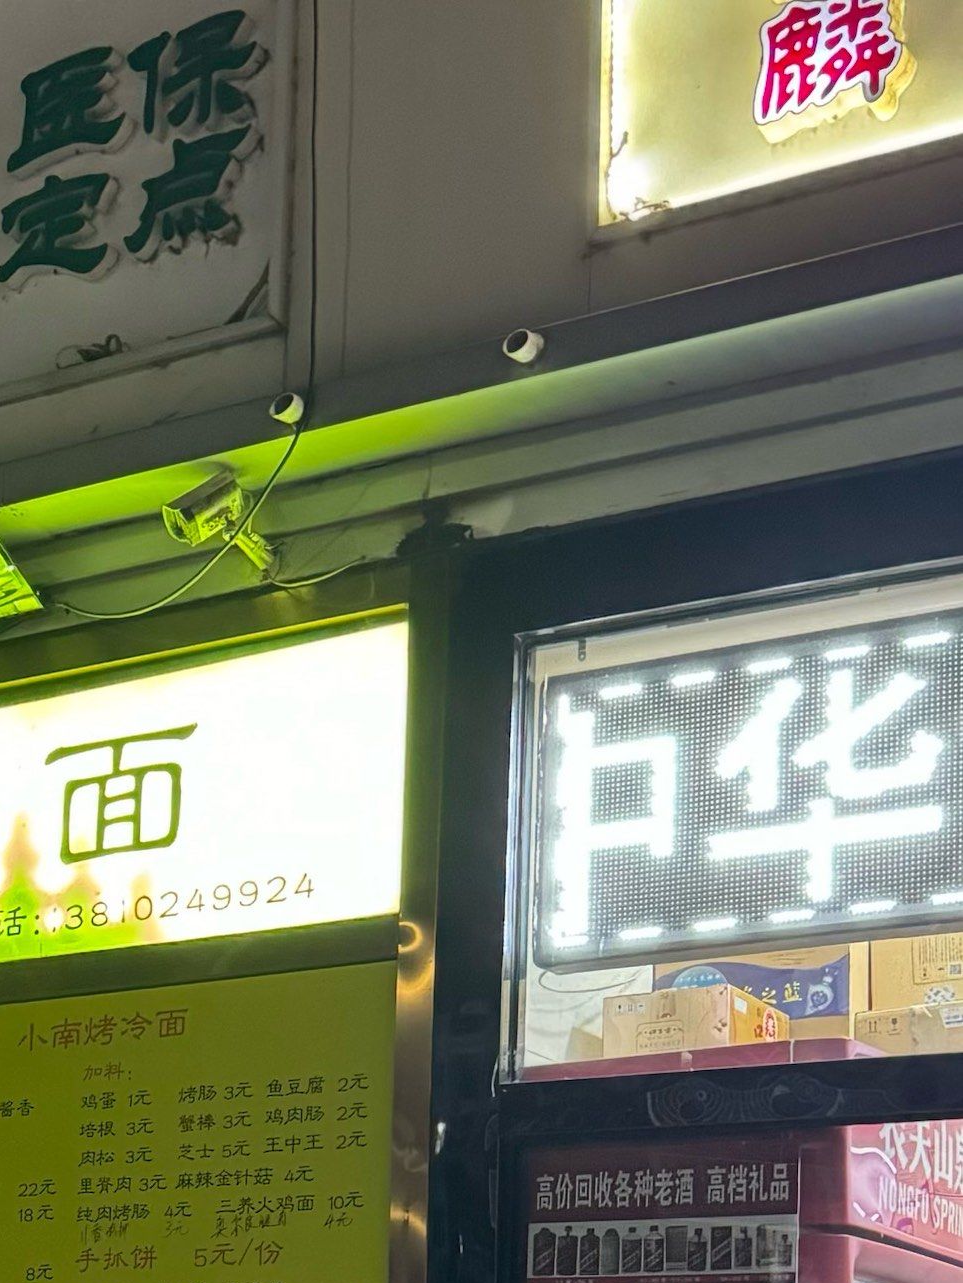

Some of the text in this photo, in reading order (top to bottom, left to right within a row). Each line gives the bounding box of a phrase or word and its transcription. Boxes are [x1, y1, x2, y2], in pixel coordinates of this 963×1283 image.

[758, 0, 901, 122] 麟
[6, 9, 258, 173] 医保
[742, 981, 802, 1005] 之蓝
[17, 1008, 190, 1051] 小南烤冷面
[83, 1062, 133, 1081] 加料:
[178, 1082, 254, 1104] 烤肠 3元
[266, 1073, 370, 1096] 鱼豆腐 2元
[81, 1090, 152, 1110] 鸡蛋 1元
[178, 1111, 252, 1132] 蟹棒 3元
[265, 1102, 368, 1125] 鸡肉肠 2元
[80, 1118, 154, 1139] 培根 3元
[177, 1141, 251, 1161] 芝士 5元
[264, 1131, 368, 1154] 王中王 2元
[78, 1147, 153, 1168] 肉松 3元
[77, 1174, 168, 1195] 里脊肉 3元
[175, 1165, 315, 1189] 麻辣金针菇 4元
[536, 1163, 790, 1211] 高价回收各种老酒 高档礼品
[18, 1179, 57, 1198] 22元
[216, 1191, 365, 1215] 三养火鸡面 10元
[878, 1176, 930, 1225] NONGFU
[18, 1204, 54, 1223] 18元
[76, 1202, 192, 1223] 纯肉烤肠 4元
[75, 1238, 283, 1273] 手抓饼 5元/份
[26, 1263, 54, 1282] 8元
